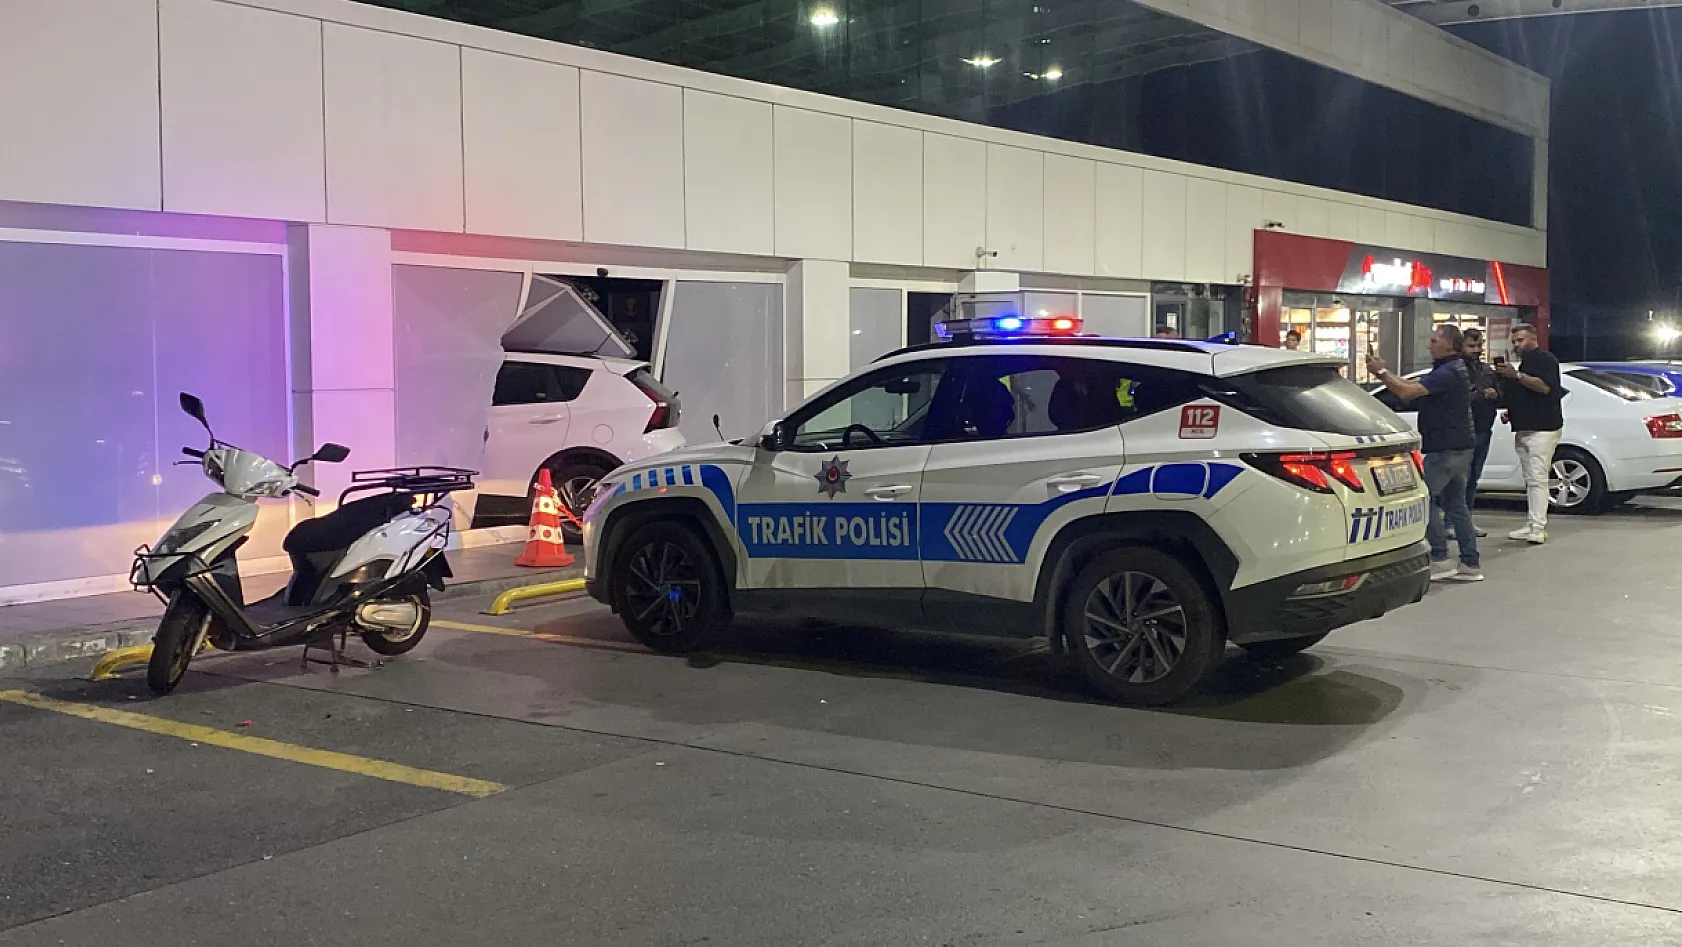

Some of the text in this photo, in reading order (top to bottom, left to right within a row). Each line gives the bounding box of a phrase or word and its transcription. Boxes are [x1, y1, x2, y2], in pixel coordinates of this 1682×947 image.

[1187, 409, 1214, 426] 112
[748, 511, 910, 546] TRAFİK POLİSİ
